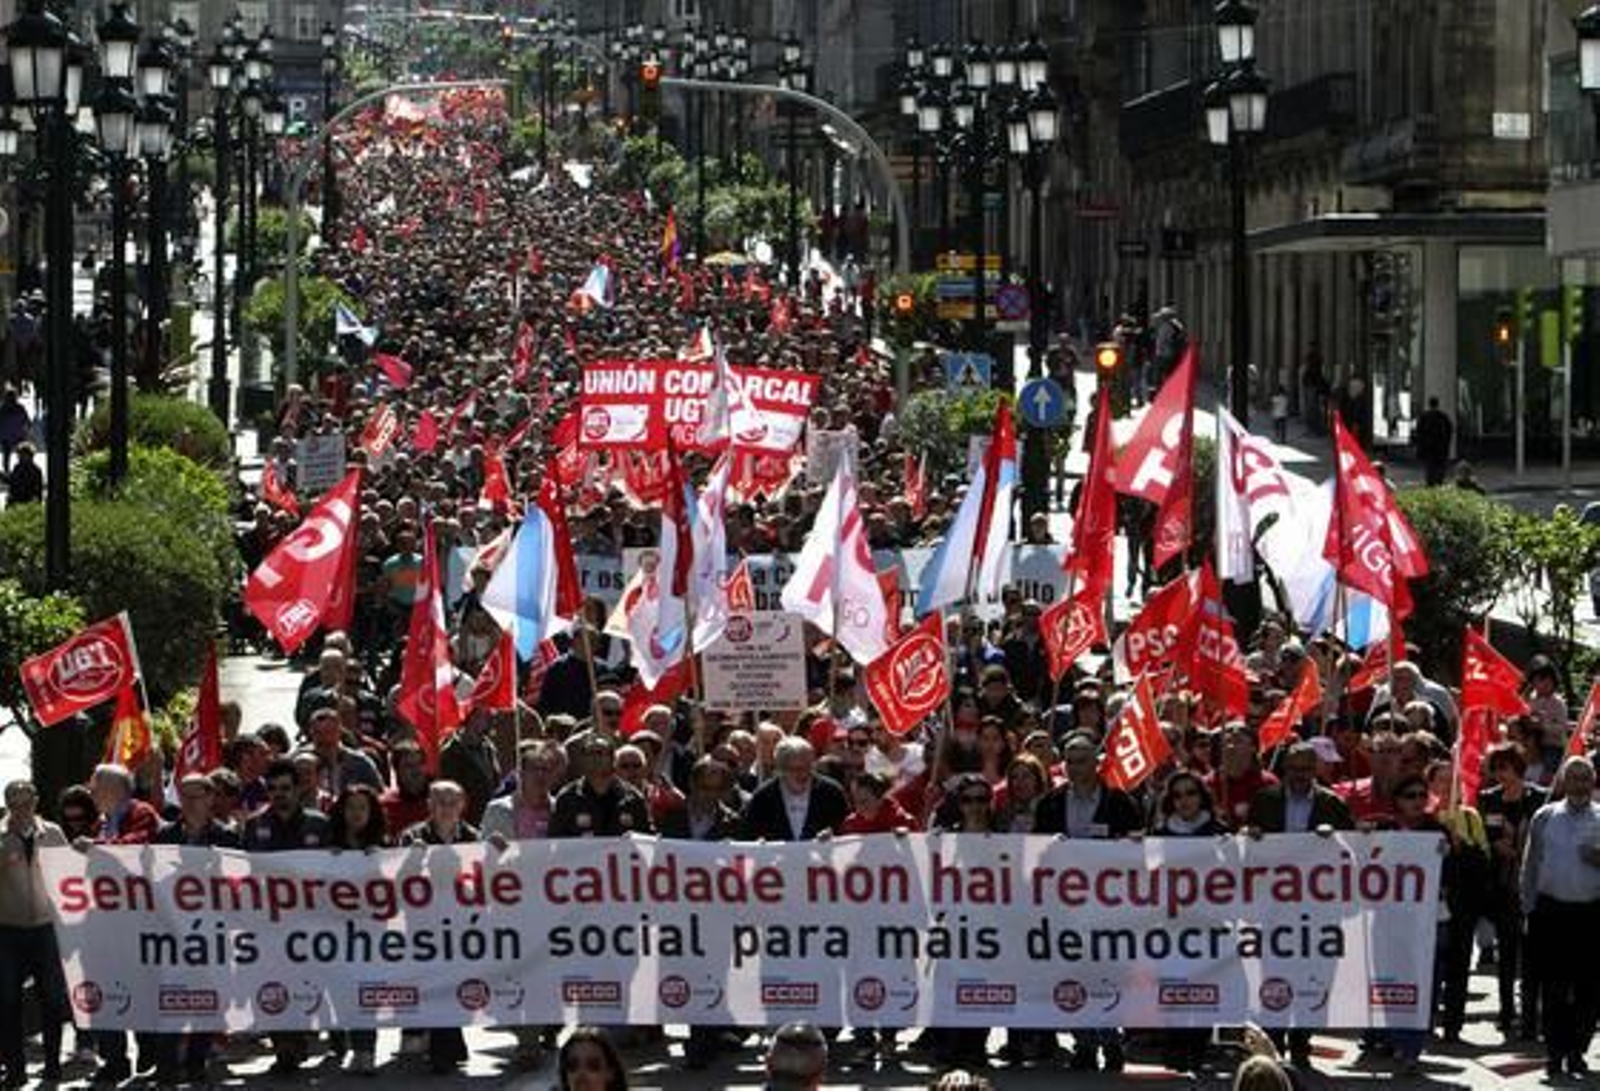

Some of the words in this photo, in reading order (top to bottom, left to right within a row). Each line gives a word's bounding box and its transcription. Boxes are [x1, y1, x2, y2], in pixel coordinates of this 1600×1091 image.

[583, 364, 656, 394] UNIÓN
[56, 641, 116, 680] UGT
[59, 873, 154, 912] sen
[173, 872, 433, 920] emprego
[455, 861, 523, 906] de
[543, 853, 786, 904] calidade
[807, 864, 910, 902] non
[932, 851, 1011, 905] hai
[1032, 847, 1426, 916] recuperación
[140, 918, 259, 965] máis
[286, 913, 521, 963] cohesión
[547, 913, 705, 957] social
[732, 923, 849, 968] para
[877, 912, 1000, 960] máis
[1026, 914, 1345, 961] democracia
